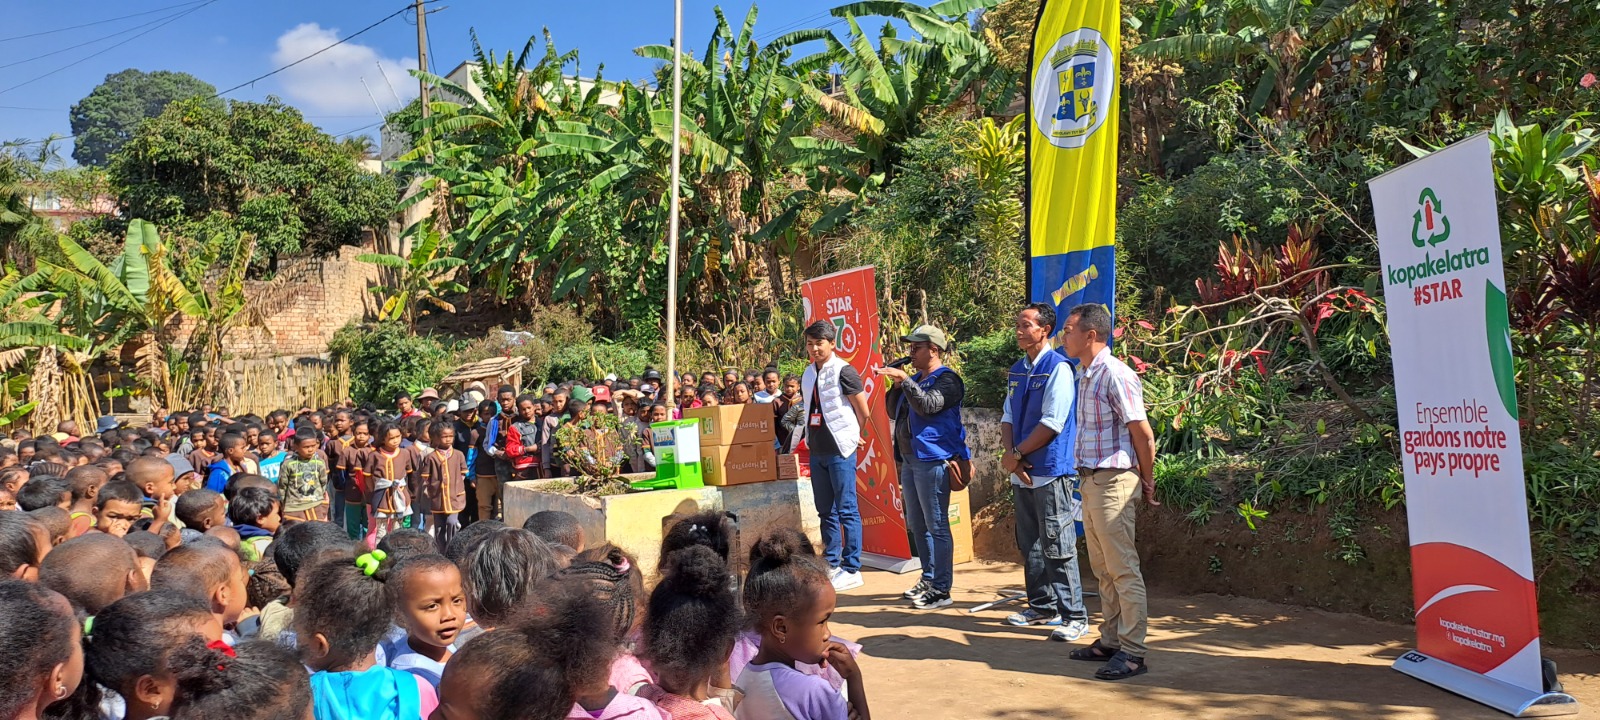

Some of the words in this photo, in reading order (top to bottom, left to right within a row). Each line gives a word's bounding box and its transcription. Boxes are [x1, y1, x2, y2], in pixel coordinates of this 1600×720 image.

[1388, 247, 1490, 288] kopakelatra
[826, 296, 853, 315] STAR
[1414, 278, 1463, 306] #STAR
[829, 315, 857, 353] 70
[1416, 399, 1488, 424] Ensemble
[1404, 424, 1461, 454] gardons
[1464, 425, 1507, 449] notre
[731, 461, 759, 470] HappyTap
[1414, 451, 1446, 475] pays
[1448, 452, 1500, 478] propre
[1452, 632, 1493, 653] kopakelatra
